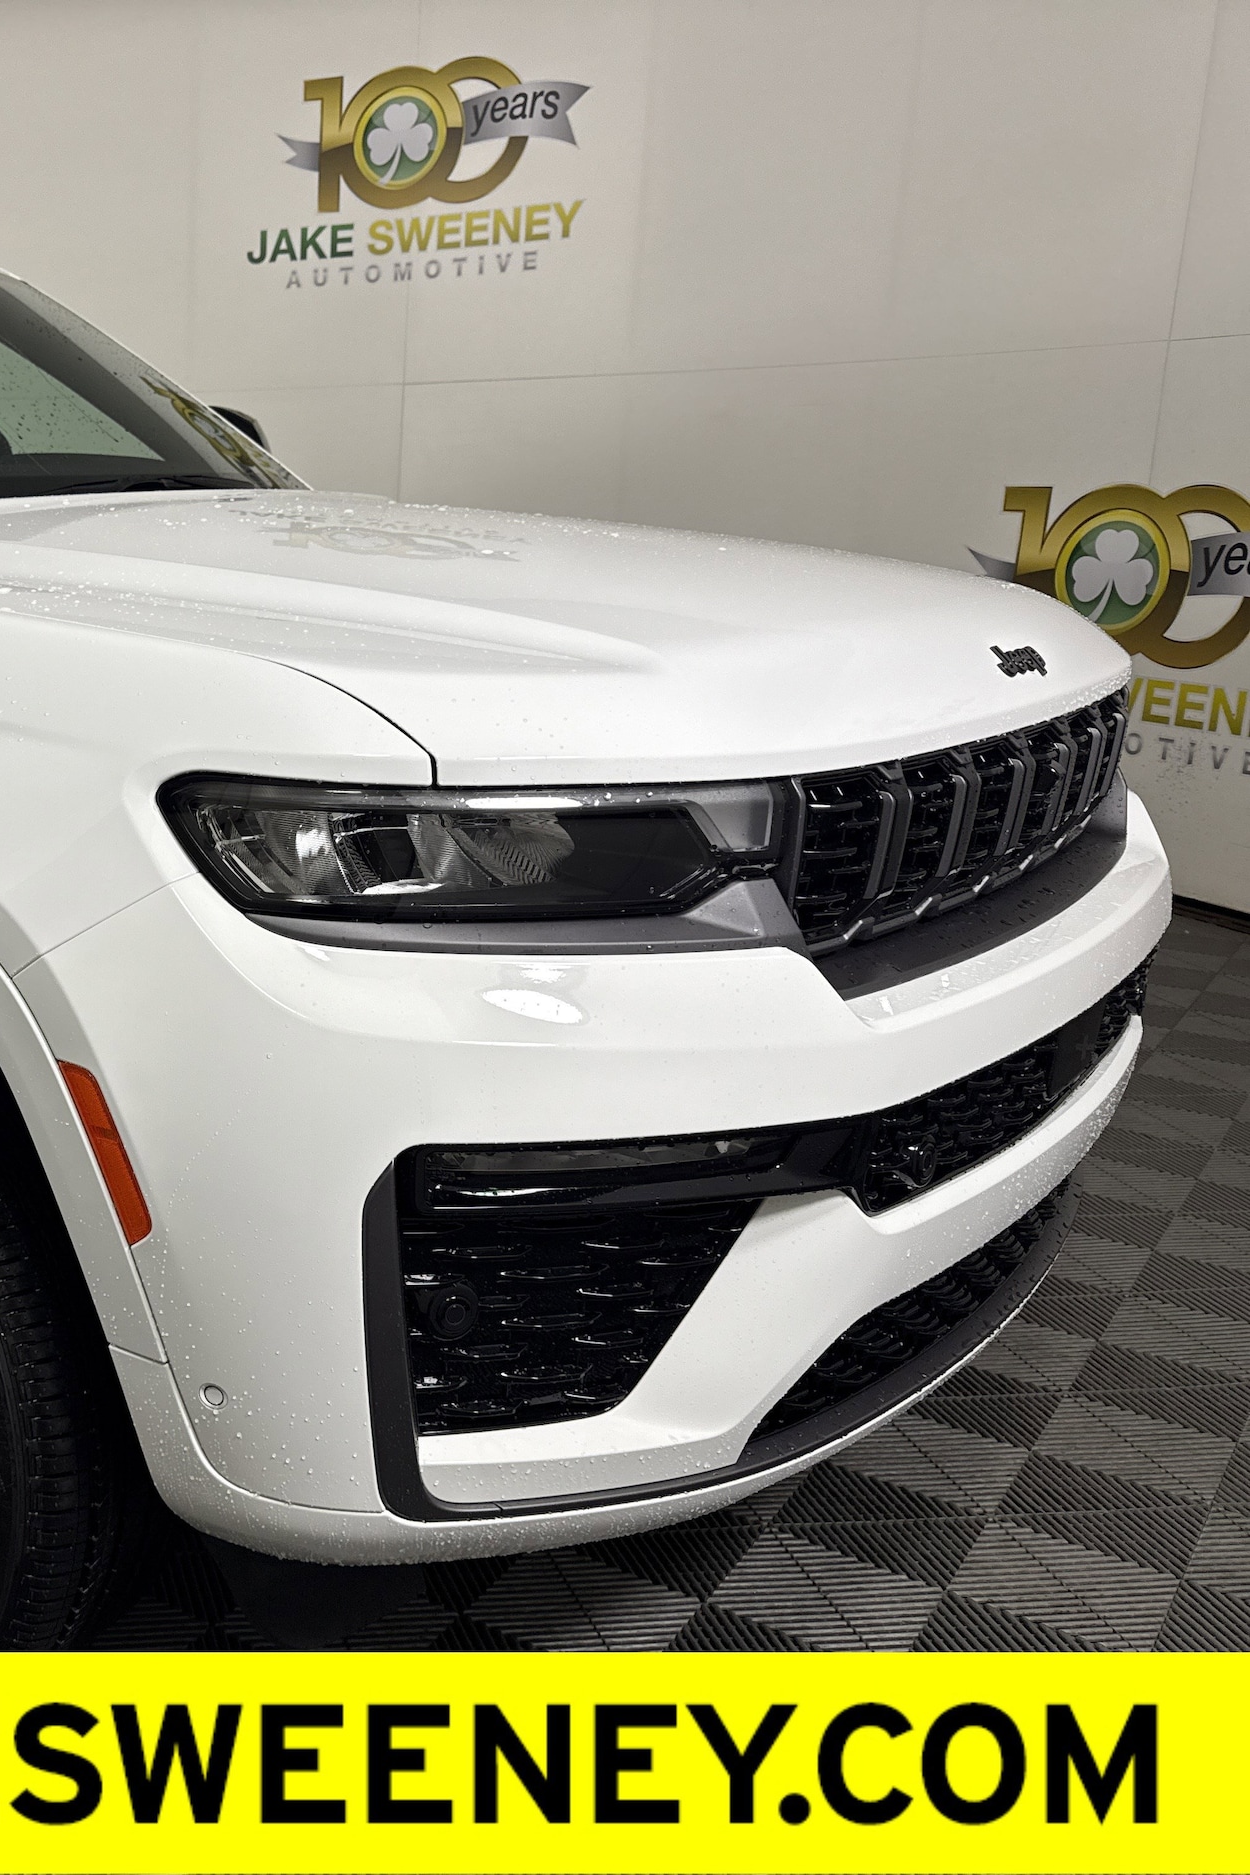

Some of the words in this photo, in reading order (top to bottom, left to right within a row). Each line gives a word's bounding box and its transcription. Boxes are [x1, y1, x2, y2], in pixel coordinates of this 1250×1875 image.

[303, 56, 530, 213] 100
[470, 89, 561, 136] years
[247, 224, 355, 264] JAKE
[367, 200, 584, 256] SWEENEY
[286, 251, 538, 289] AUTOMOTIVE
[989, 645, 1047, 678] Jeep
